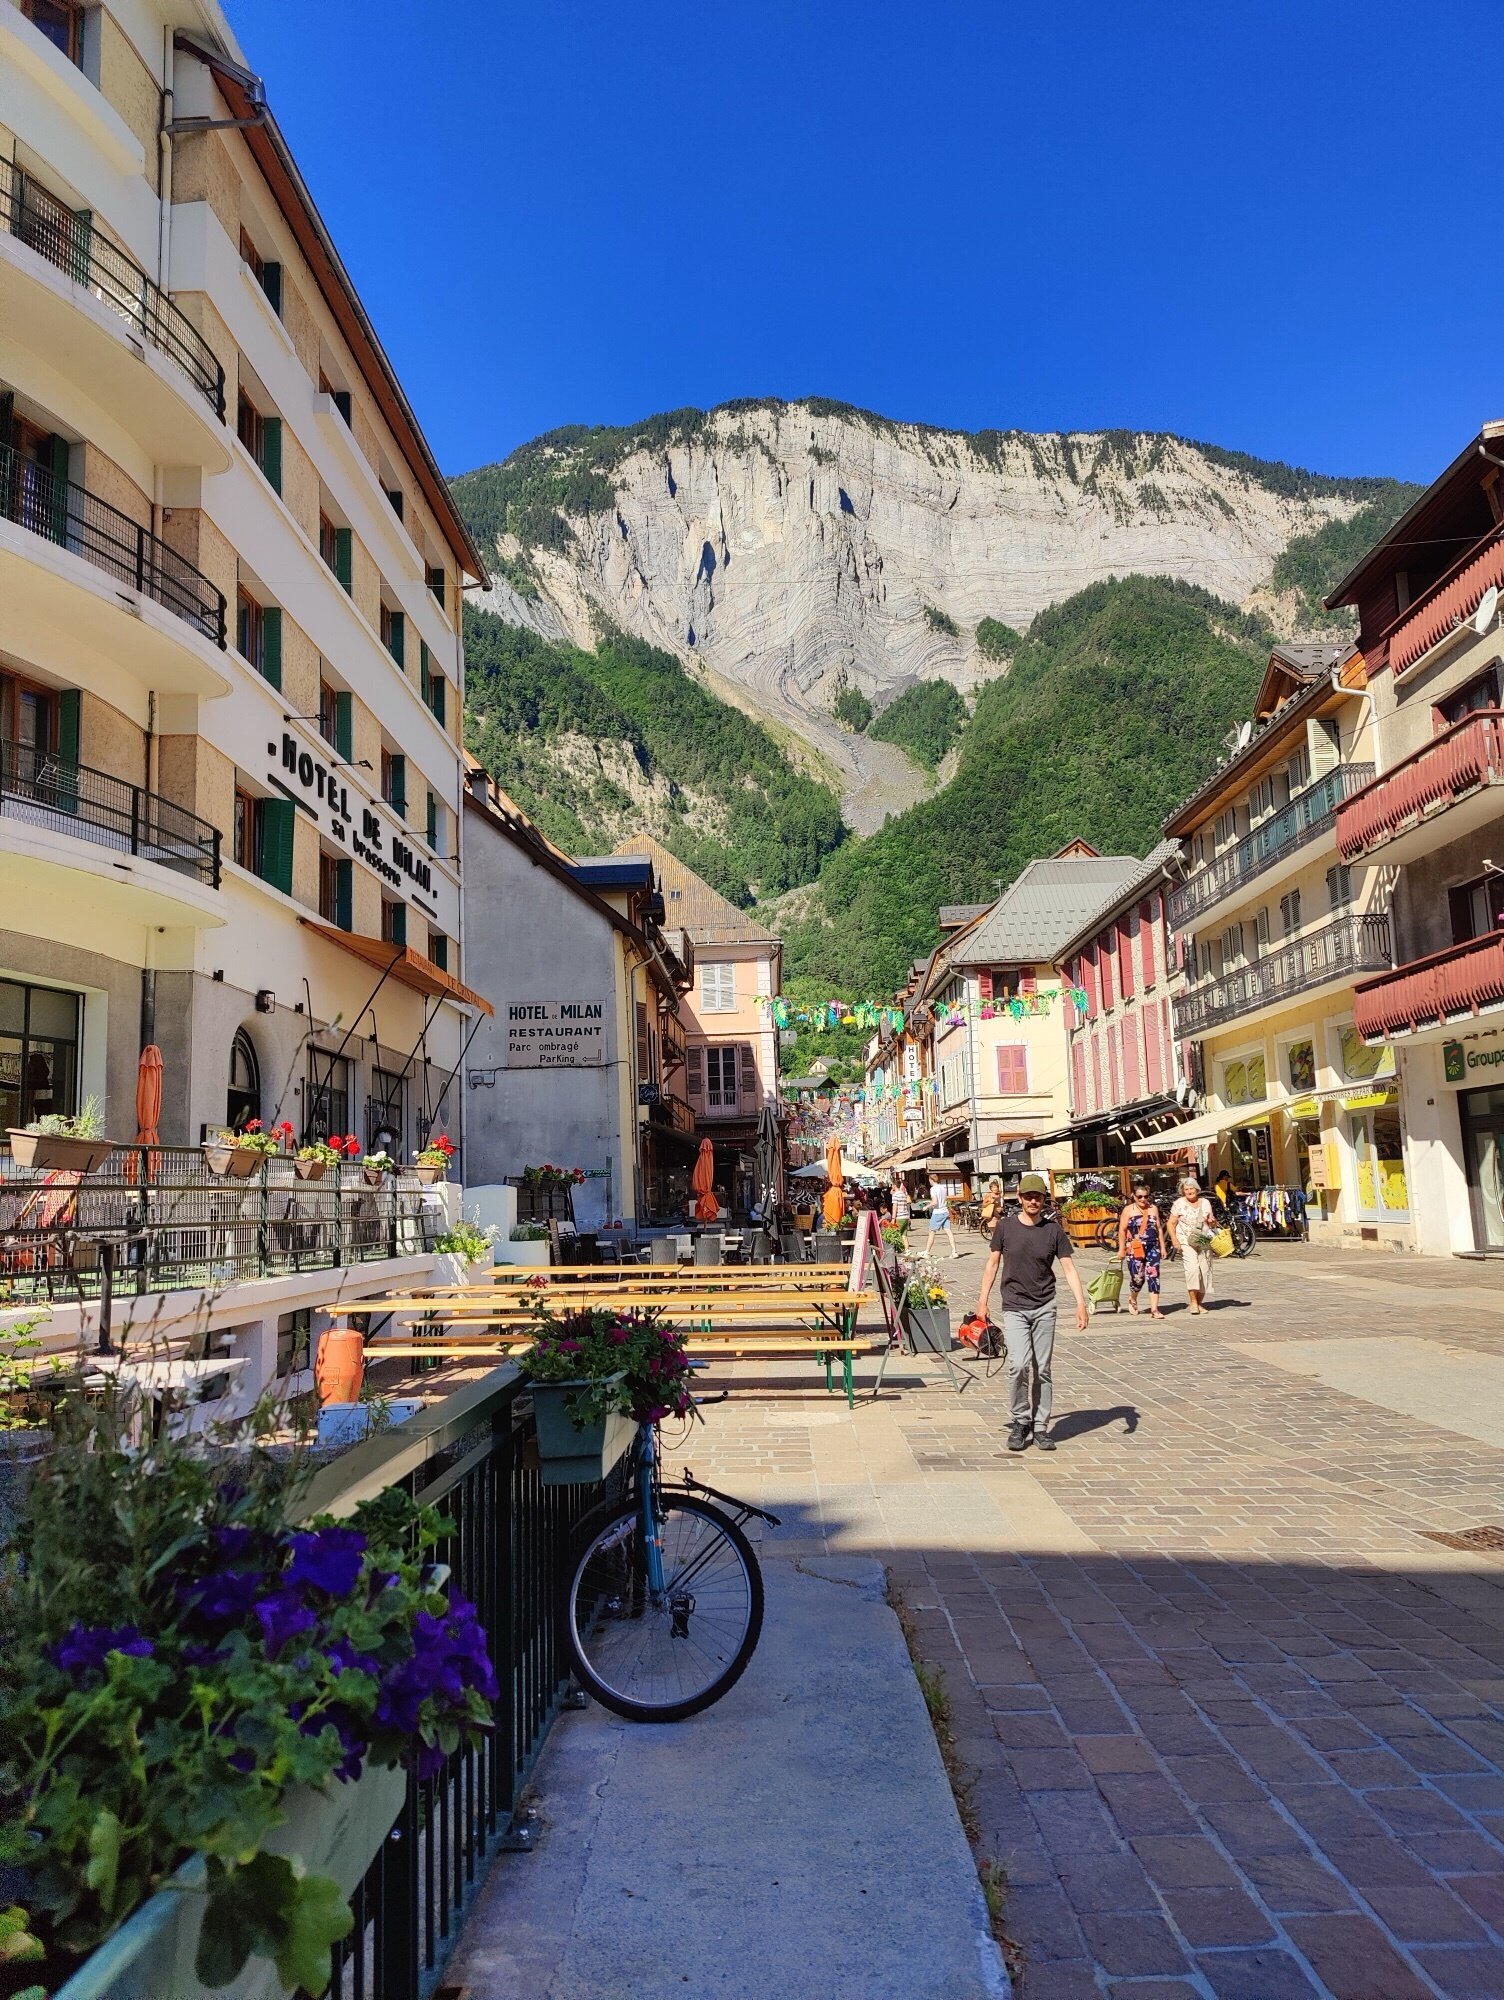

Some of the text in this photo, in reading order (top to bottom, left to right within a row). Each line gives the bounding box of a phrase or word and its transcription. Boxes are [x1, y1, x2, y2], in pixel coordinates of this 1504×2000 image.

[362, 808, 383, 850] DE
[352, 830, 402, 888] brasserie
[447, 975, 456, 990] LE
[456, 982, 481, 1008] CRISTAL
[509, 1005, 548, 1020] HOTEL
[560, 1004, 602, 1019] MILAN
[509, 1026, 602, 1038] RESTAURANT
[509, 1041, 579, 1053] Parc ombragé
